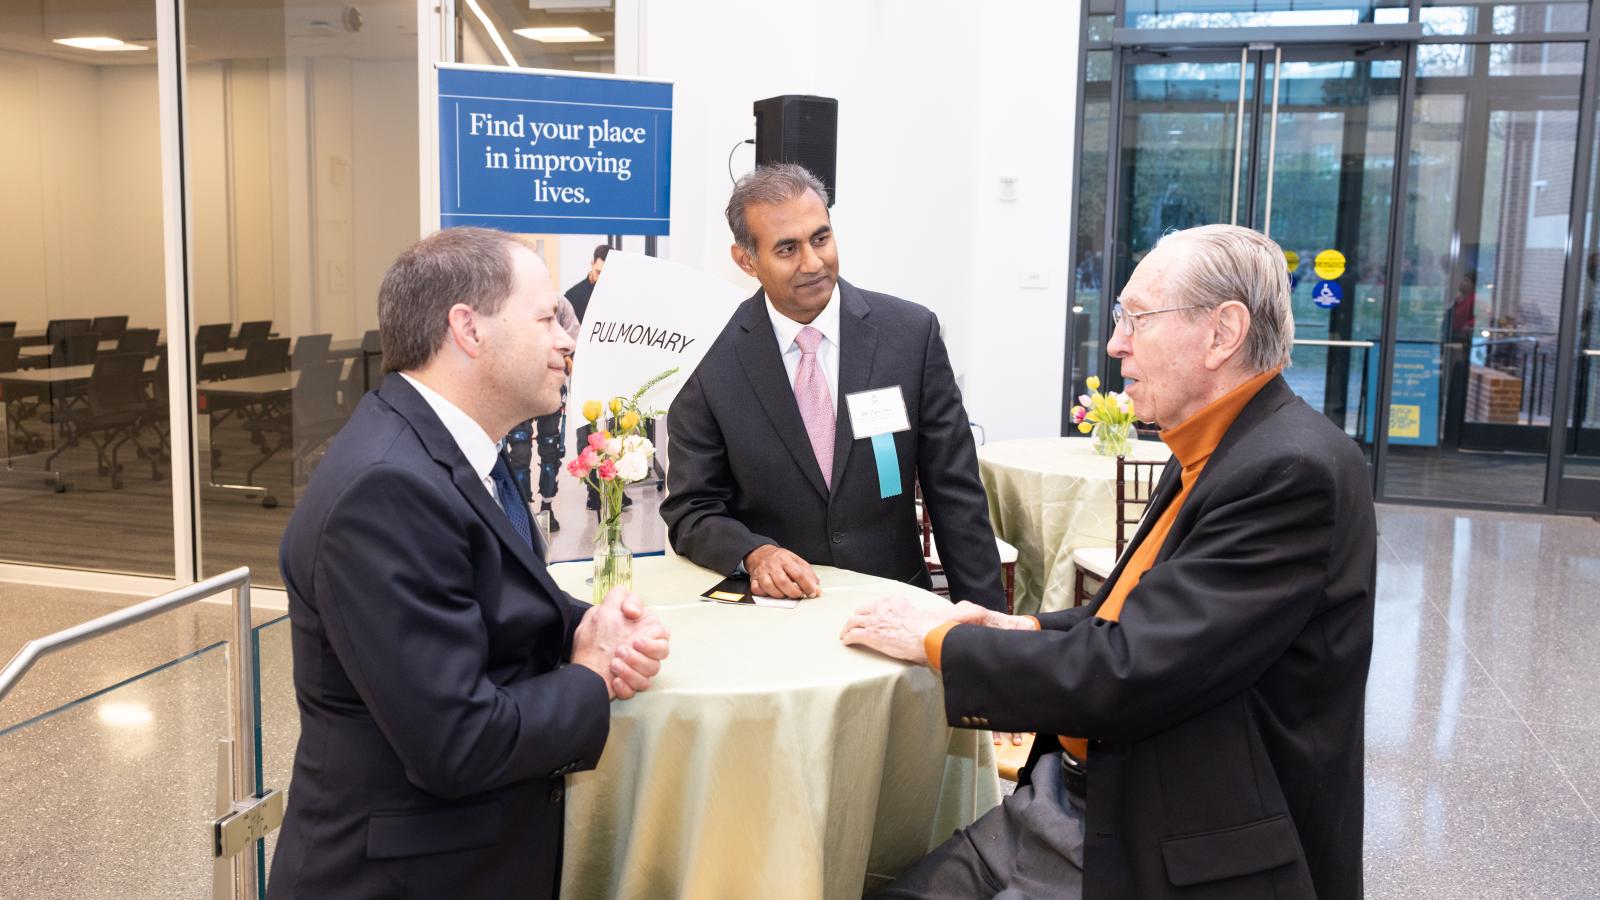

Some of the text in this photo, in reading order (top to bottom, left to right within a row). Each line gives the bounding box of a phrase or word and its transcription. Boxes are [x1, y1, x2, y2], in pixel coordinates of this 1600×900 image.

[469, 112, 646, 148] Find your place
[485, 146, 632, 181] in improving
[534, 179, 591, 204] lives.
[589, 321, 696, 354] PULMONARY
